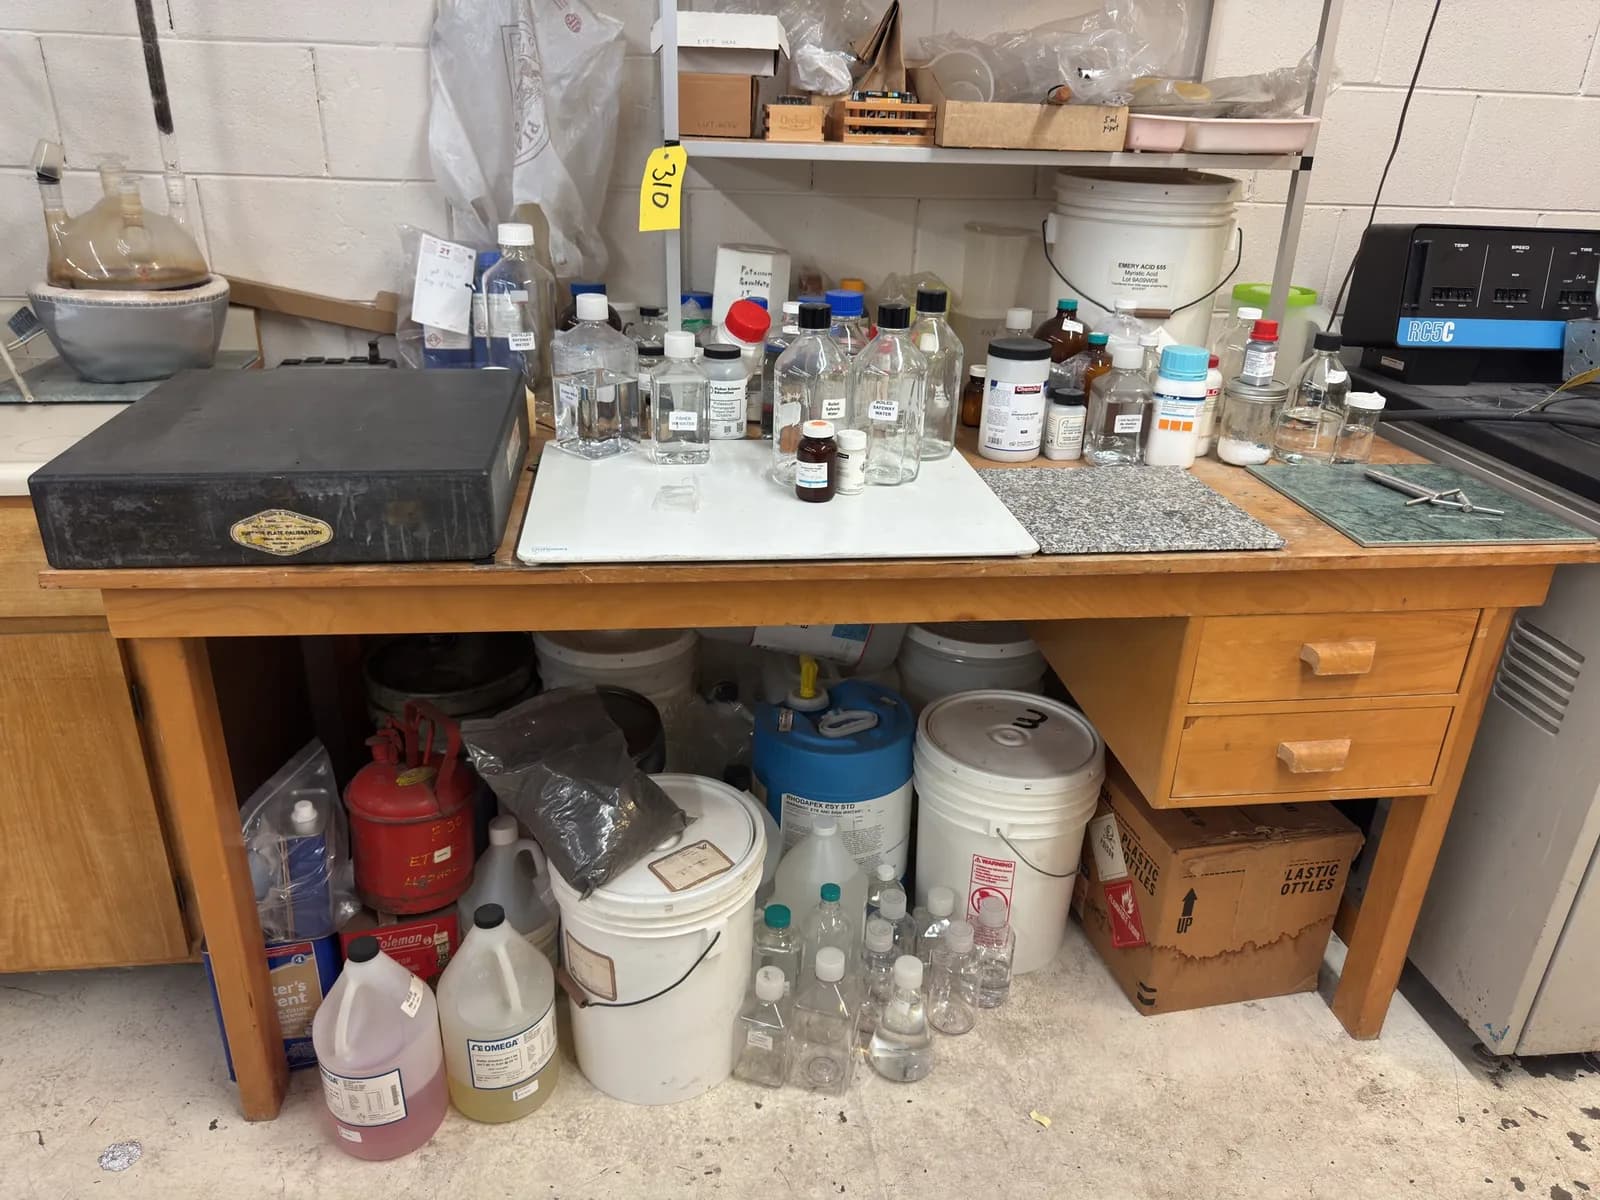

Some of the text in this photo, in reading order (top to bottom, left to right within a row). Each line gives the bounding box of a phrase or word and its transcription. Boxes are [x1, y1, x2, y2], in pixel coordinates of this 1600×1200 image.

[652, 163, 676, 209] 310
[1118, 262, 1140, 270] EMERY
[1407, 320, 1456, 343] RC5C
[284, 528, 322, 536] CALIBRATION
[982, 858, 1013, 868] WARNING
[1121, 832, 1160, 882] PLASTIC
[1122, 850, 1157, 897] OTTLES
[1284, 863, 1340, 882] LASTIC
[1280, 878, 1335, 896] OTTLES
[1176, 917, 1194, 934] UP
[376, 933, 422, 949] oleman
[273, 980, 307, 996] ter's
[278, 992, 307, 1007] ent
[484, 1039, 518, 1052] OMEGA
